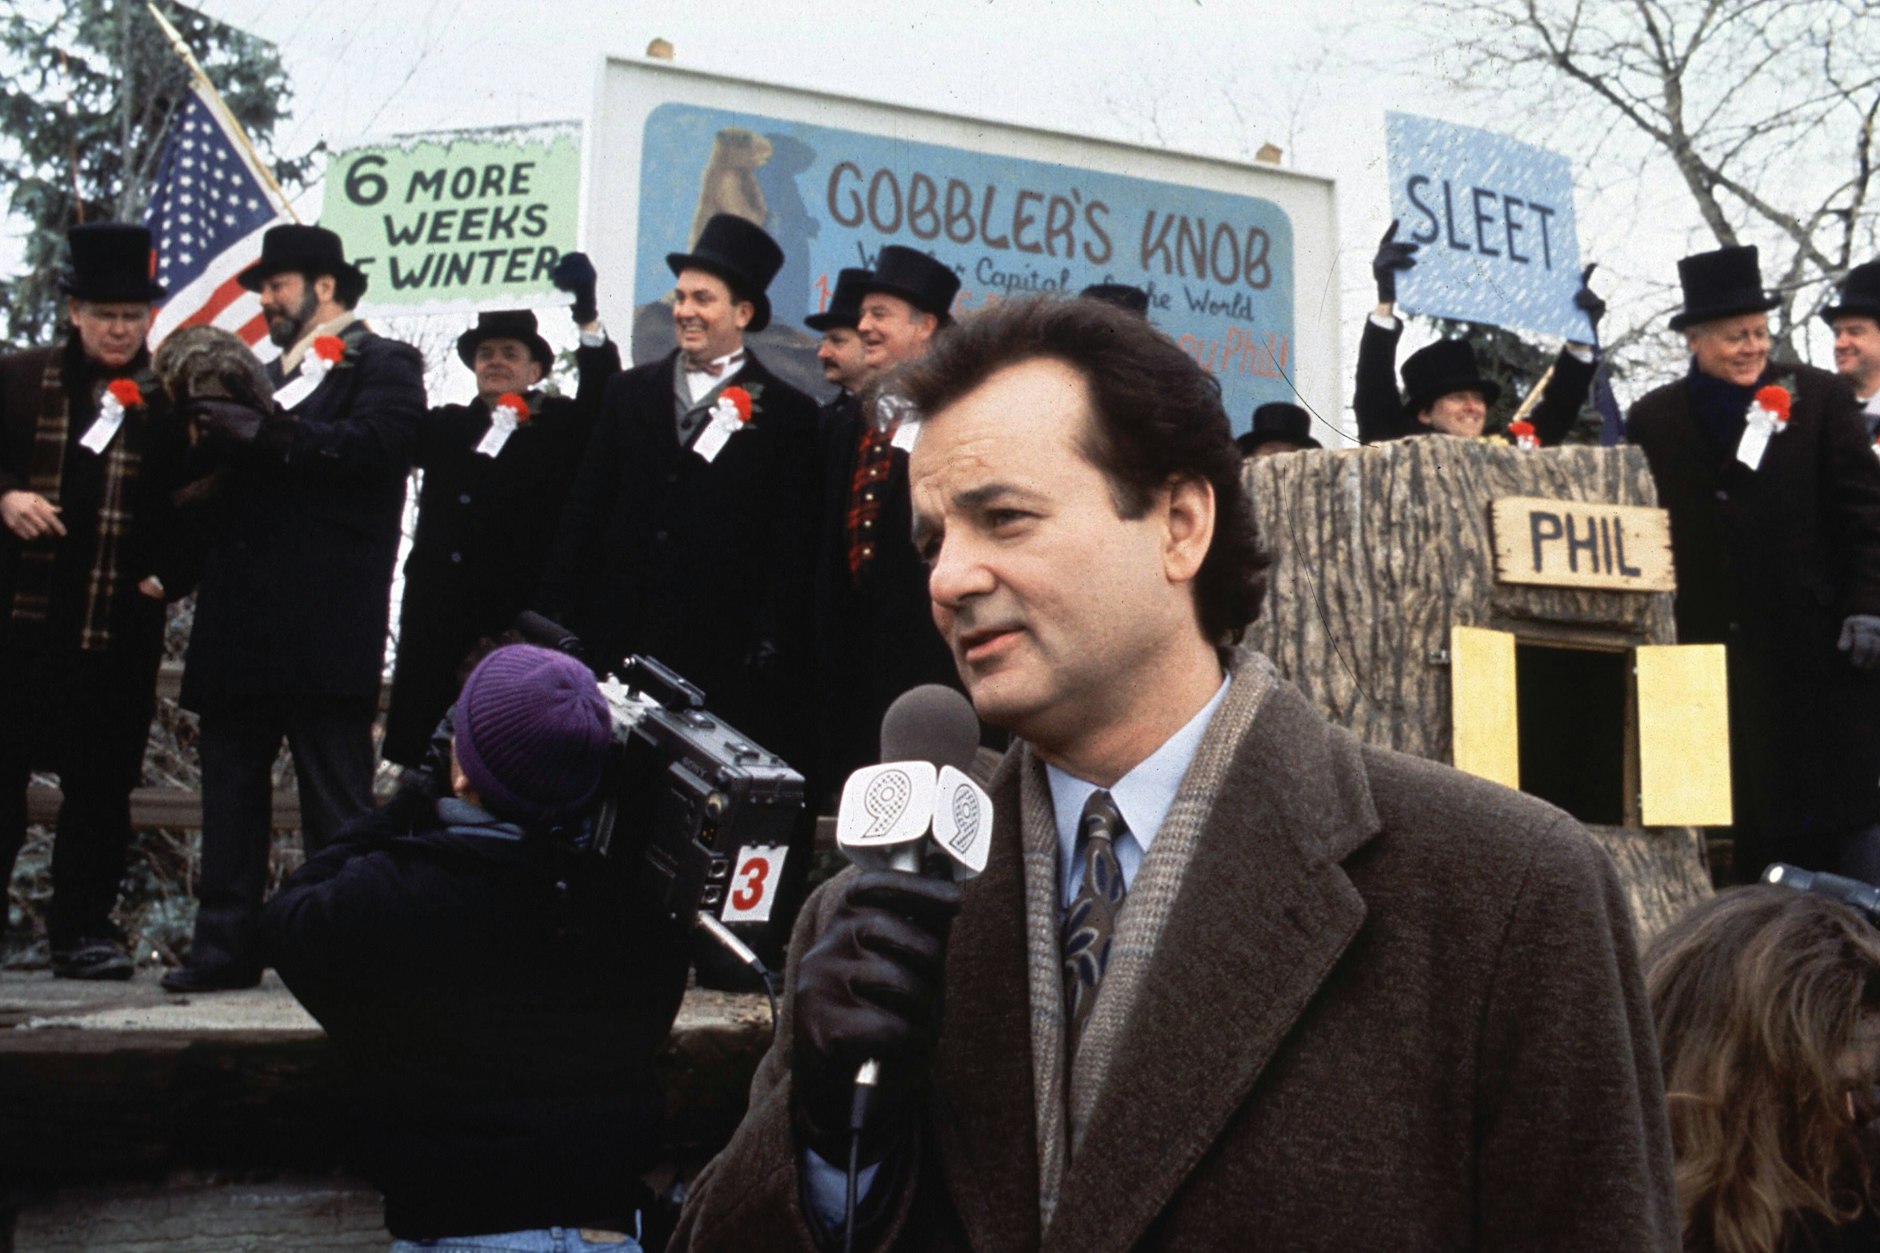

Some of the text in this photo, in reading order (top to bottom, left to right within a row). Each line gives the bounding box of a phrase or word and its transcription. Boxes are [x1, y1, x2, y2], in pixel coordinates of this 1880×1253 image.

[345, 155, 535, 206] 6 MORE
[384, 203, 548, 246] WEEKS
[827, 161, 1273, 291] GOBBLER'S KNOB
[1406, 174, 1555, 271] SLEET
[389, 246, 560, 290] WINTER
[976, 256, 1070, 295] Capital
[1184, 286, 1254, 322] World
[1529, 511, 1641, 577] PHIL
[862, 769, 912, 838] 9
[949, 783, 981, 854] 9
[732, 857, 769, 911] 3
